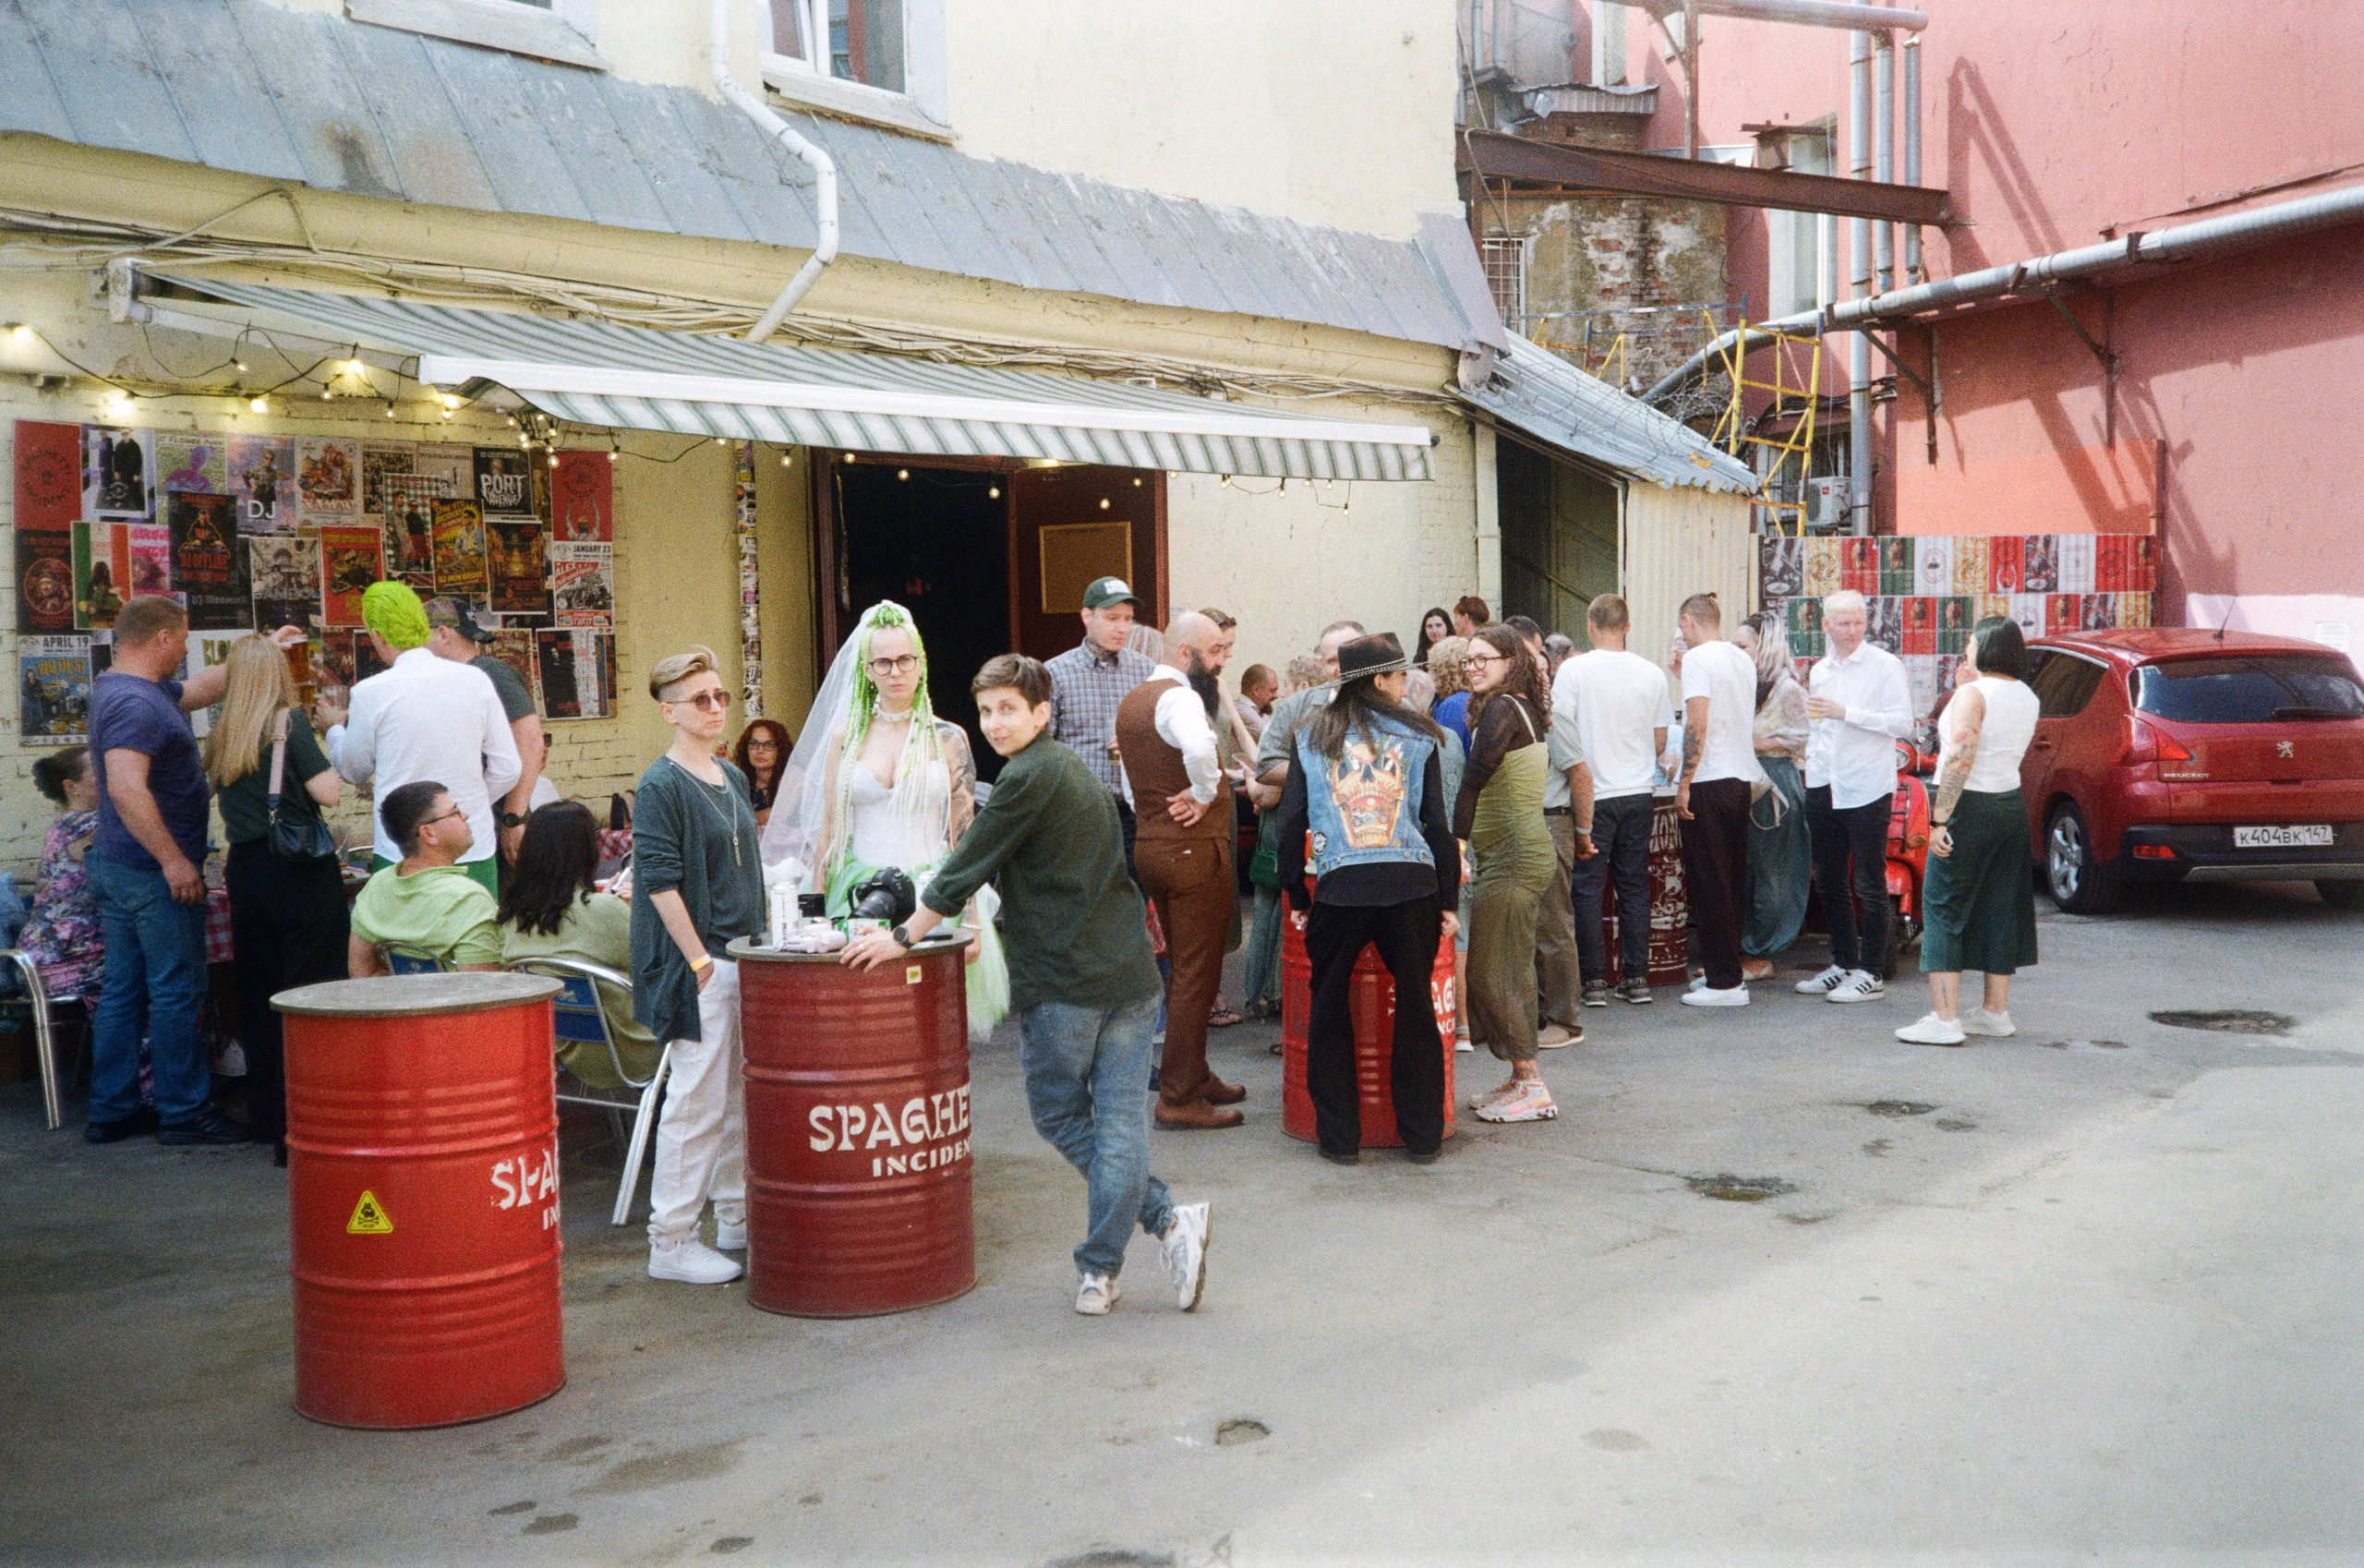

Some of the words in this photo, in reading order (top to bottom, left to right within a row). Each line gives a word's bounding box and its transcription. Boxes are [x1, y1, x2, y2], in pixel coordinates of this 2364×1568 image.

[480, 474, 528, 504] PORT
[247, 500, 276, 519] DJ
[573, 545, 600, 553] JANUARY
[603, 545, 611, 553] 23
[43, 637, 73, 647] APRIL
[77, 637, 89, 647] 19
